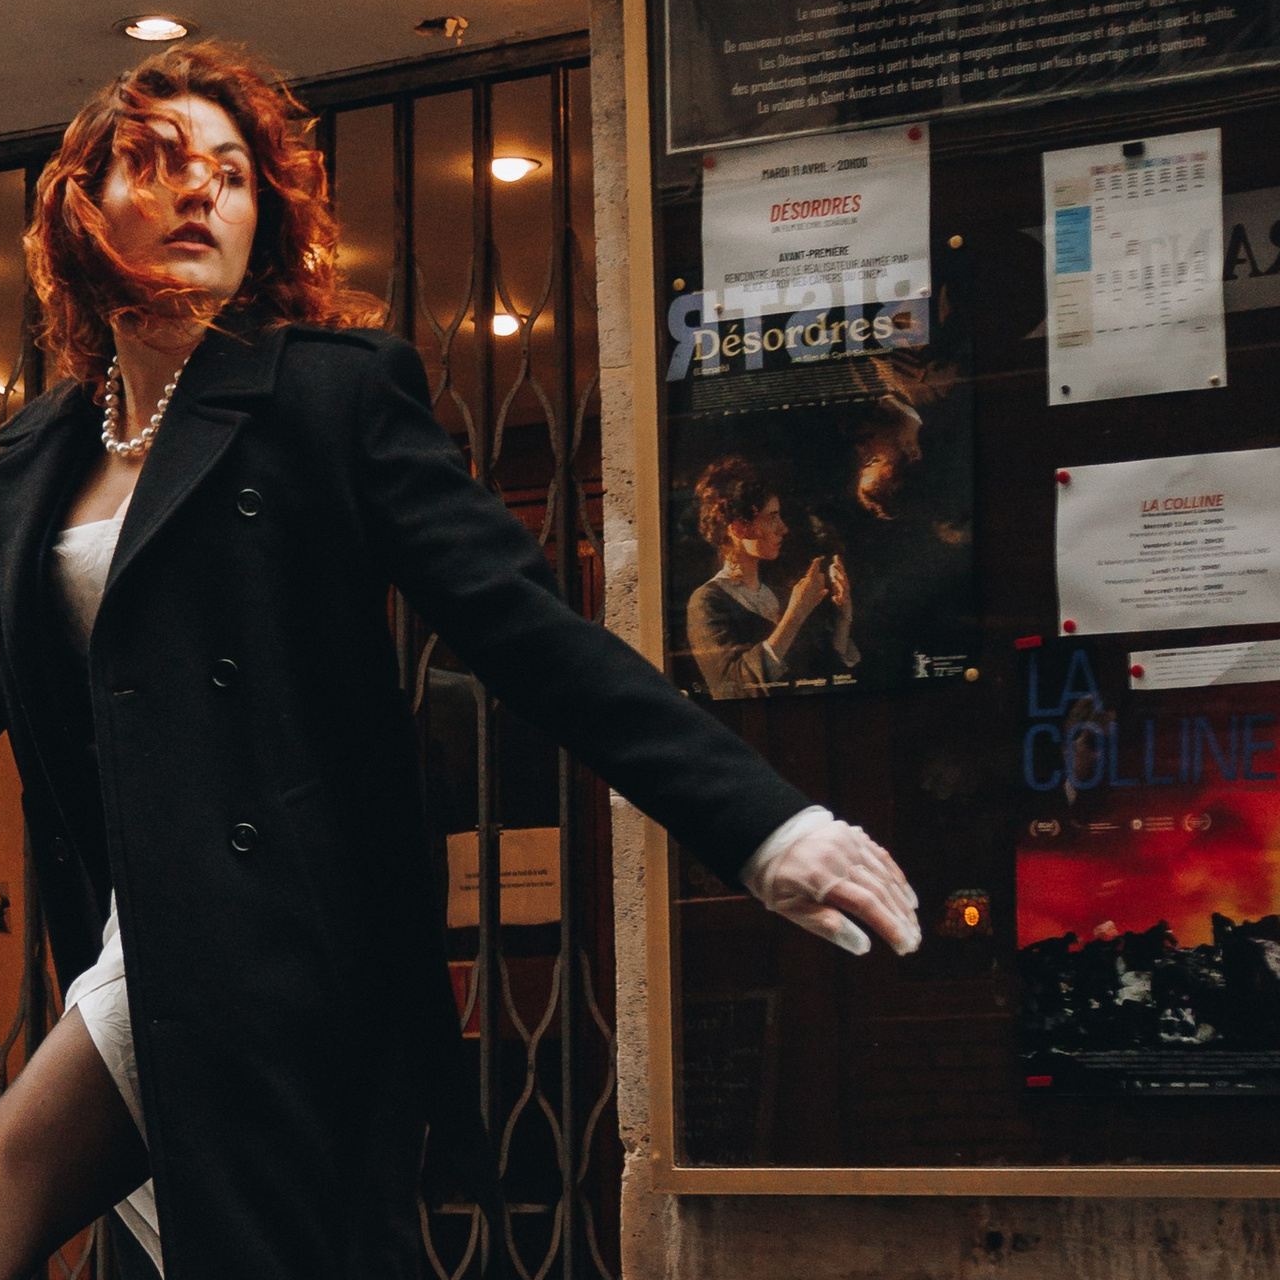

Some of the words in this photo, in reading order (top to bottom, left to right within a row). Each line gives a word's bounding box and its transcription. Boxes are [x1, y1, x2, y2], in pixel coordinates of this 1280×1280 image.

[762, 166, 790, 180] MARDI
[801, 162, 828, 175] AVRIL
[770, 195, 862, 222] DÉSORDRES
[724, 269, 769, 283] RENCONTRE
[692, 313, 895, 361] Désordres
[1141, 499, 1158, 513] LA
[1163, 494, 1225, 511] COLLINE
[1028, 649, 1106, 718] LA
[1023, 714, 1277, 791] COLLINE
